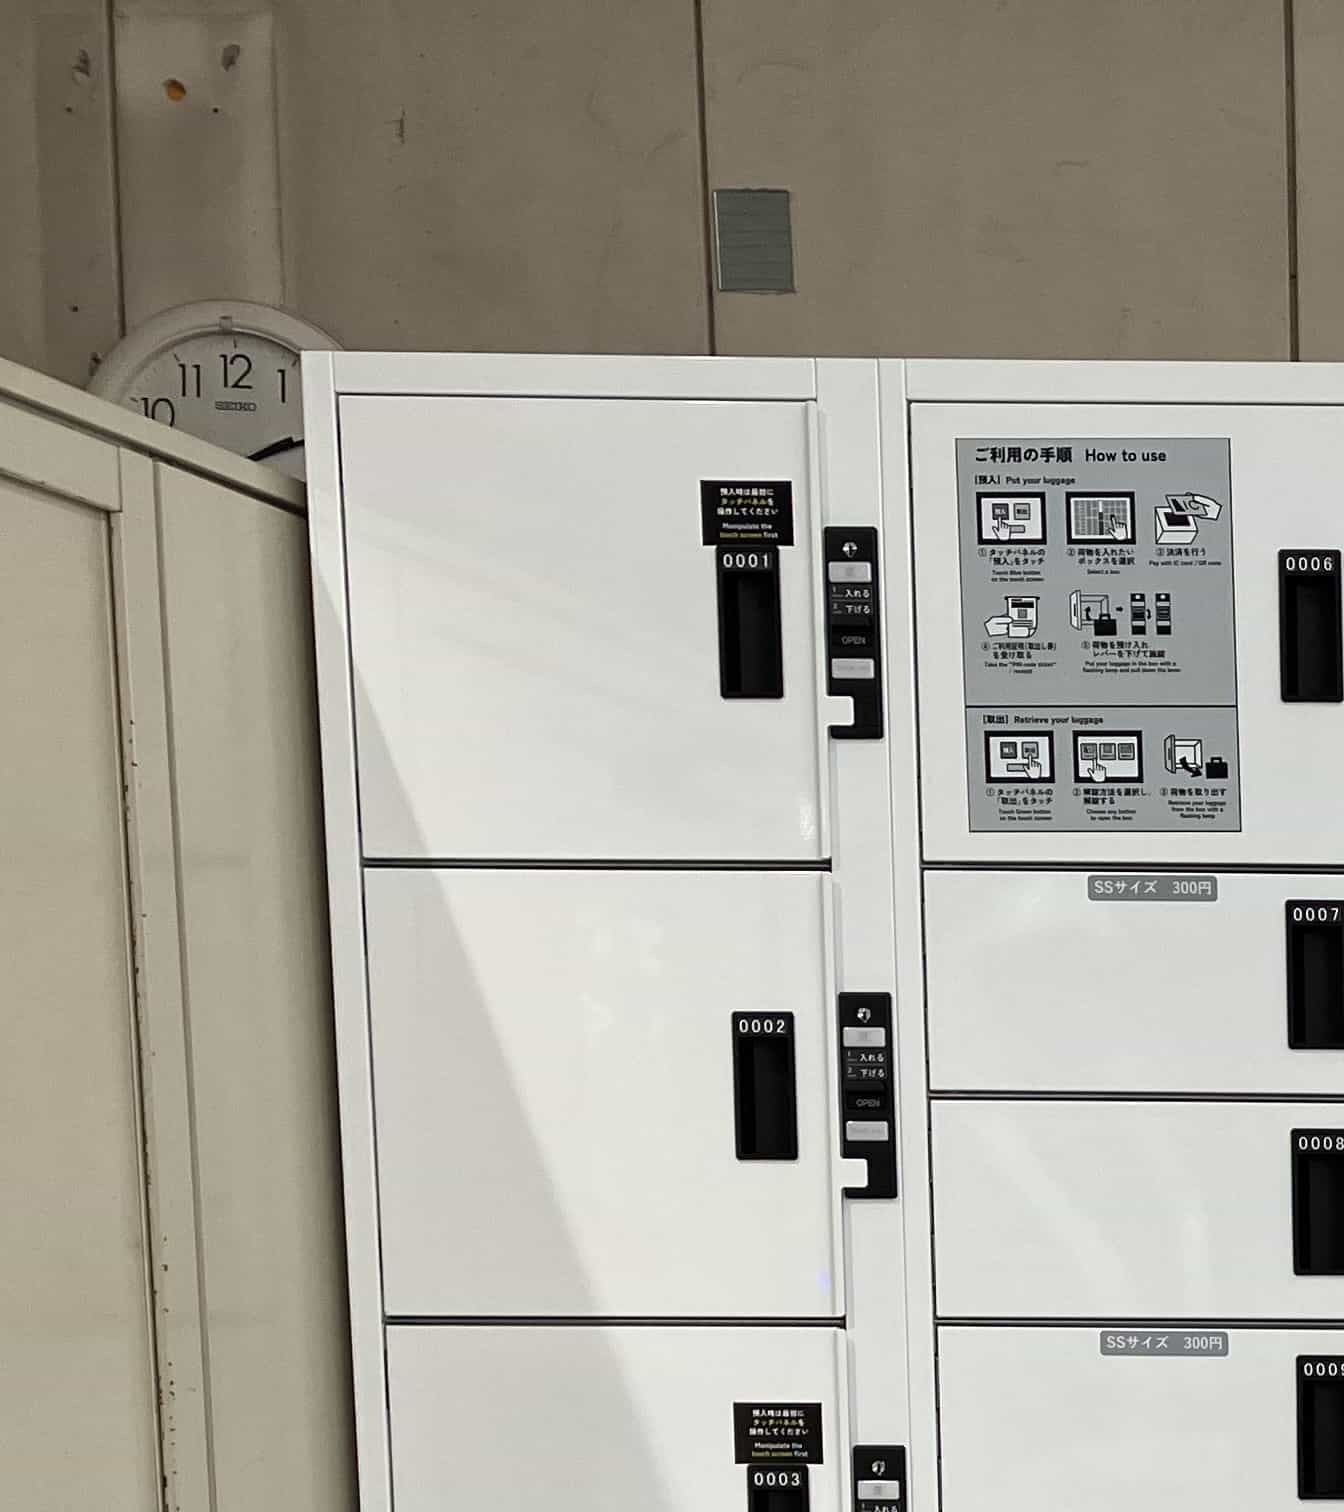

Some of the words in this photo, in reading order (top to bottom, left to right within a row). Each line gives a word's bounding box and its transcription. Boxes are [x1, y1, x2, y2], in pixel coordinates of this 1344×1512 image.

[219, 355, 253, 389] 12
[178, 364, 200, 397] 11
[277, 369, 285, 403] 1
[215, 402, 256, 411] SEIKO
[976, 447, 1072, 463] ご利用の手順
[1085, 450, 1117, 461] How
[1122, 451, 1136, 461] to
[1143, 452, 1166, 461] use
[1023, 478, 1041, 486] your
[1044, 477, 1075, 486] luggage
[723, 554, 768, 568] 0001
[1286, 557, 1333, 571] 0006
[841, 636, 866, 645] OPEN
[1014, 716, 1049, 724] Retrieve
[1051, 717, 1069, 725] your
[1071, 716, 1103, 725] luggage
[1094, 880, 1158, 894] SSサイズ
[1172, 881, 1211, 895] 300円
[1294, 908, 1339, 920] 0007
[739, 1020, 785, 1033] 0002
[856, 1099, 880, 1107] OPEN
[1299, 1137, 1344, 1150] 0008
[1106, 1336, 1168, 1349] SSサイズ
[1184, 1337, 1222, 1350] 300円
[754, 1473, 800, 1485] 0003
